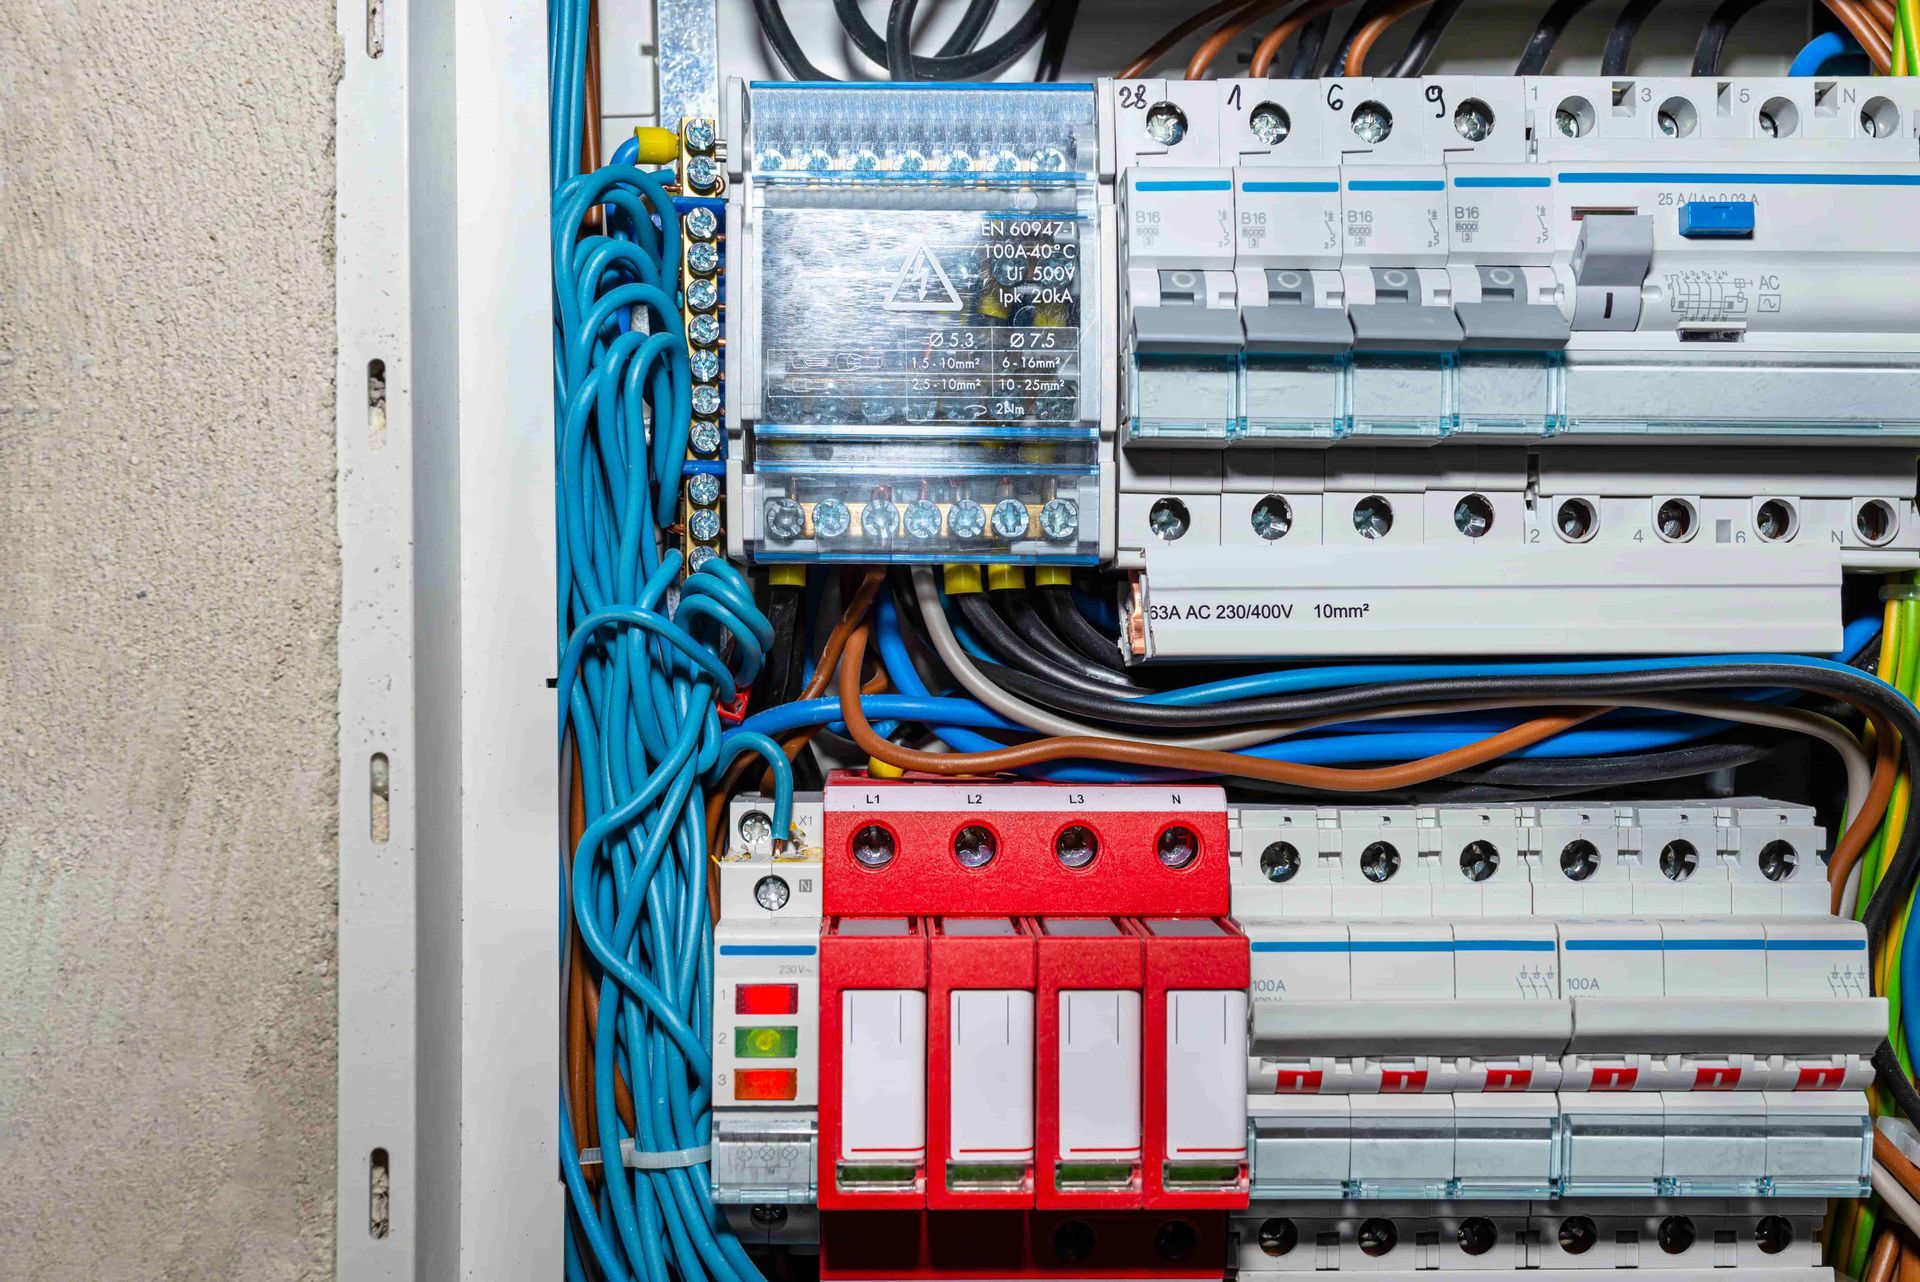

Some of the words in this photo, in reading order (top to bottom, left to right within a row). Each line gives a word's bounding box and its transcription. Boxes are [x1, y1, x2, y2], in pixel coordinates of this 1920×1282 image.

[1119, 84, 1147, 109] 28
[1227, 84, 1241, 111] 1
[1327, 84, 1343, 111] 6
[1531, 87, 1538, 101] 1
[1641, 88, 1652, 102] 3
[1739, 89, 1750, 103] 5
[1843, 89, 1856, 103] N
[1425, 85, 1446, 118] 9
[1658, 193, 1674, 206] 25
[1136, 211, 1161, 224] B16
[1241, 212, 1267, 225] B16
[1348, 210, 1373, 223] B16
[1455, 206, 1480, 219] B16
[981, 221, 1004, 237] EN
[1009, 221, 1075, 237] 60947-1
[1242, 228, 1265, 237] 6000
[1349, 227, 1371, 236] 6000
[1456, 223, 1477, 231] 6000
[1032, 265, 1076, 281] 500V
[1759, 274, 1780, 291] AC
[1031, 288, 1074, 304] 20kA
[948, 332, 974, 348] 5.3
[1030, 332, 1055, 348] 7.5
[912, 358, 929, 369] 1.5
[1002, 358, 1010, 369] 6
[911, 379, 931, 391] 2.5
[1000, 379, 1015, 391] 10
[996, 402, 1025, 416] 2Nm
[1530, 529, 1541, 543] 2
[1632, 529, 1643, 543] 4
[1735, 531, 1746, 543] 6
[1831, 530, 1844, 544] N
[1150, 605, 1181, 620] 63A
[1186, 605, 1211, 620] AC
[1216, 604, 1293, 620] 230/400V
[1313, 603, 1369, 619] 10mm²
[866, 795, 880, 804] L1
[967, 795, 982, 804] L2
[1069, 794, 1084, 804] L3
[1172, 795, 1181, 804] N
[799, 816, 814, 826] X1
[801, 880, 811, 890] N
[1252, 979, 1287, 992] 100A
[1566, 978, 1600, 990] 100A
[721, 989, 726, 1000] 1
[718, 1032, 727, 1045] 2
[718, 1074, 727, 1086] 3
